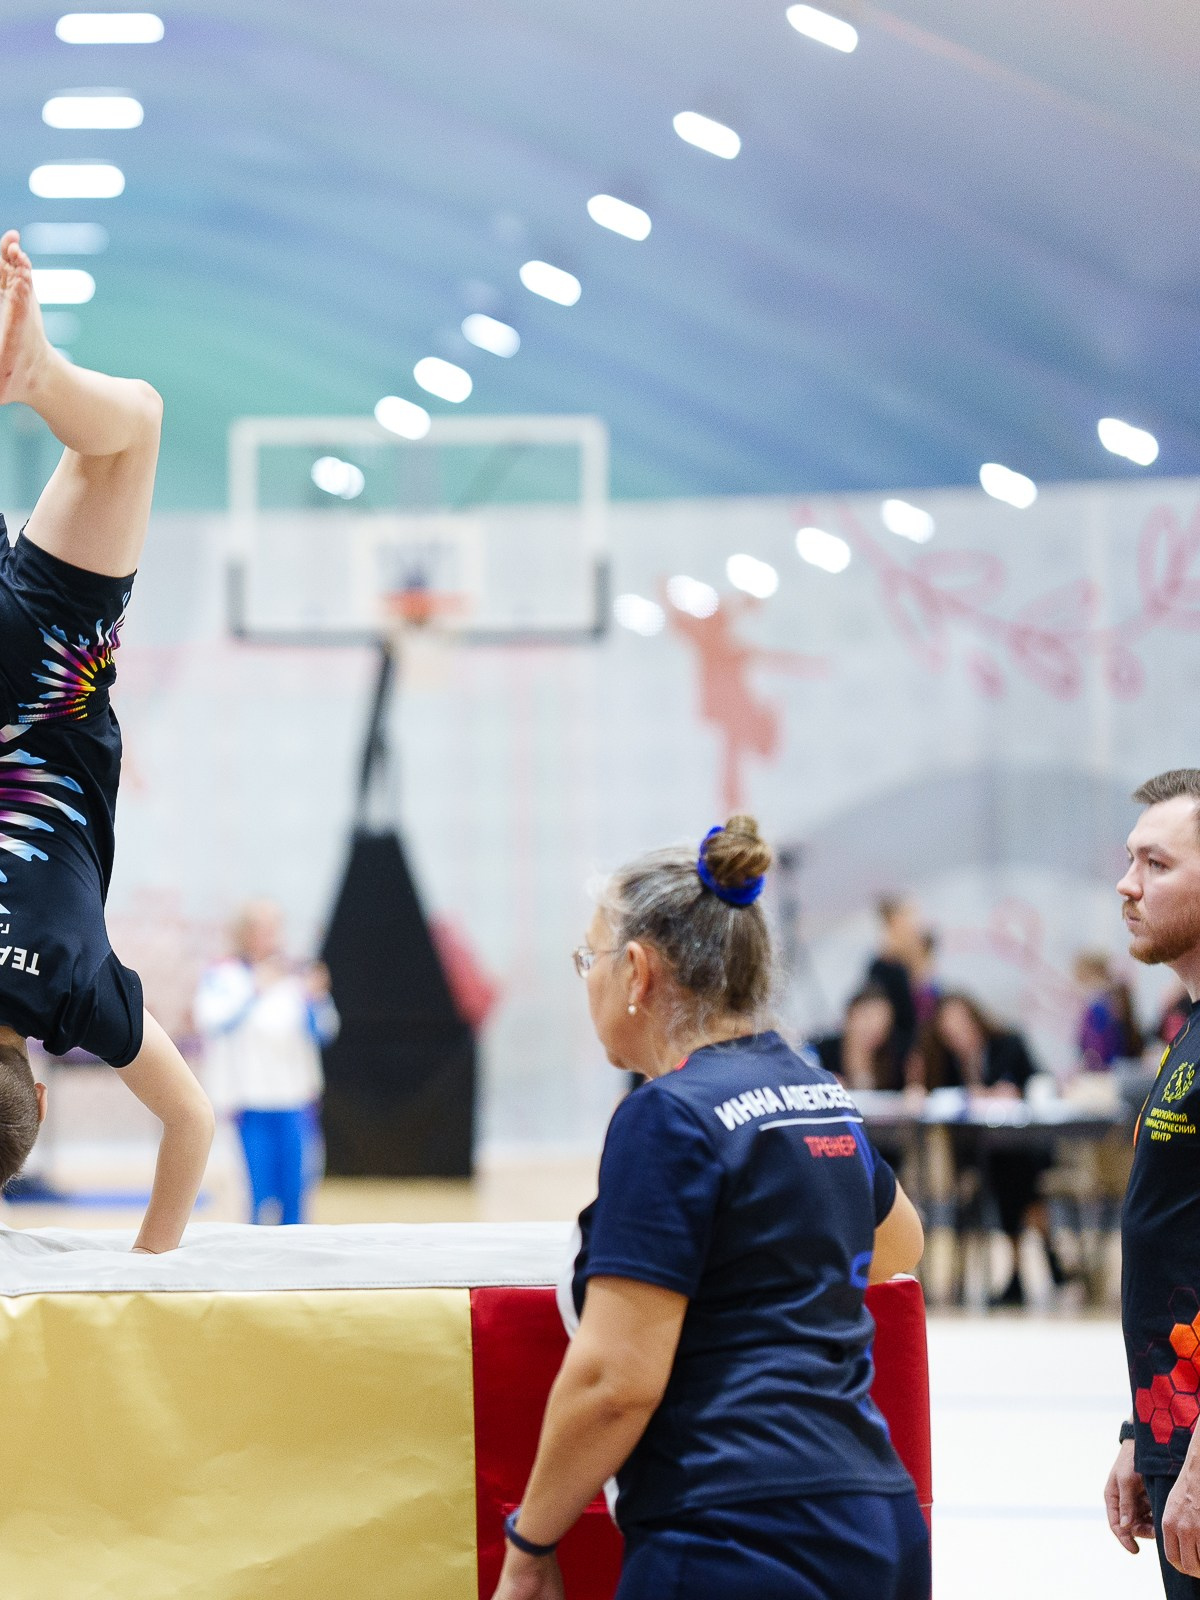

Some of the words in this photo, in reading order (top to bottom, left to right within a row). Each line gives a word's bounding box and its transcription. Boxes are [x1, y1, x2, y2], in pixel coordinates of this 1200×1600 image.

[713, 1086, 785, 1131] ИННА
[803, 1134, 858, 1158] ТРЕНЕР
[1150, 1130, 1172, 1142] ЦЕНТР
